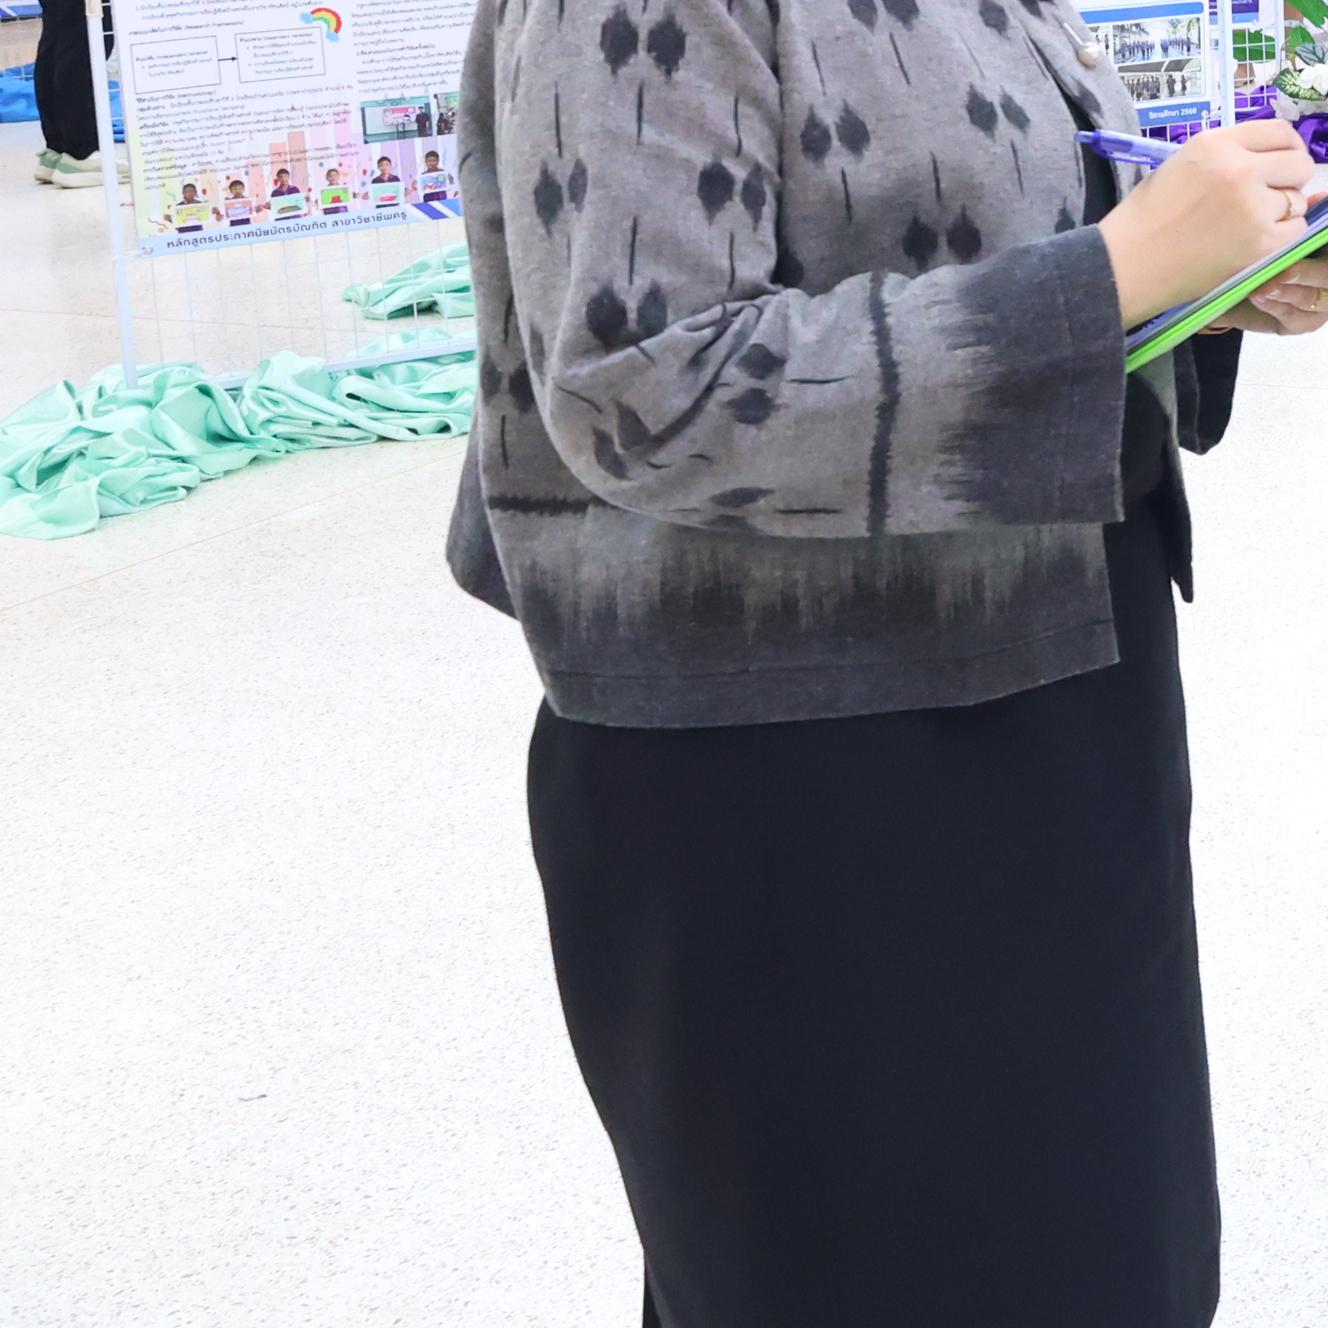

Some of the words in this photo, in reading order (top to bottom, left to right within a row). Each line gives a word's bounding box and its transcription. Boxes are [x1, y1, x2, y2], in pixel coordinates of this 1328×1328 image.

[167, 221, 328, 249] หลักสูตรประกาศนียบัตรบัณฑิต
[332, 212, 408, 228] สาขาวิชาชีพครู
